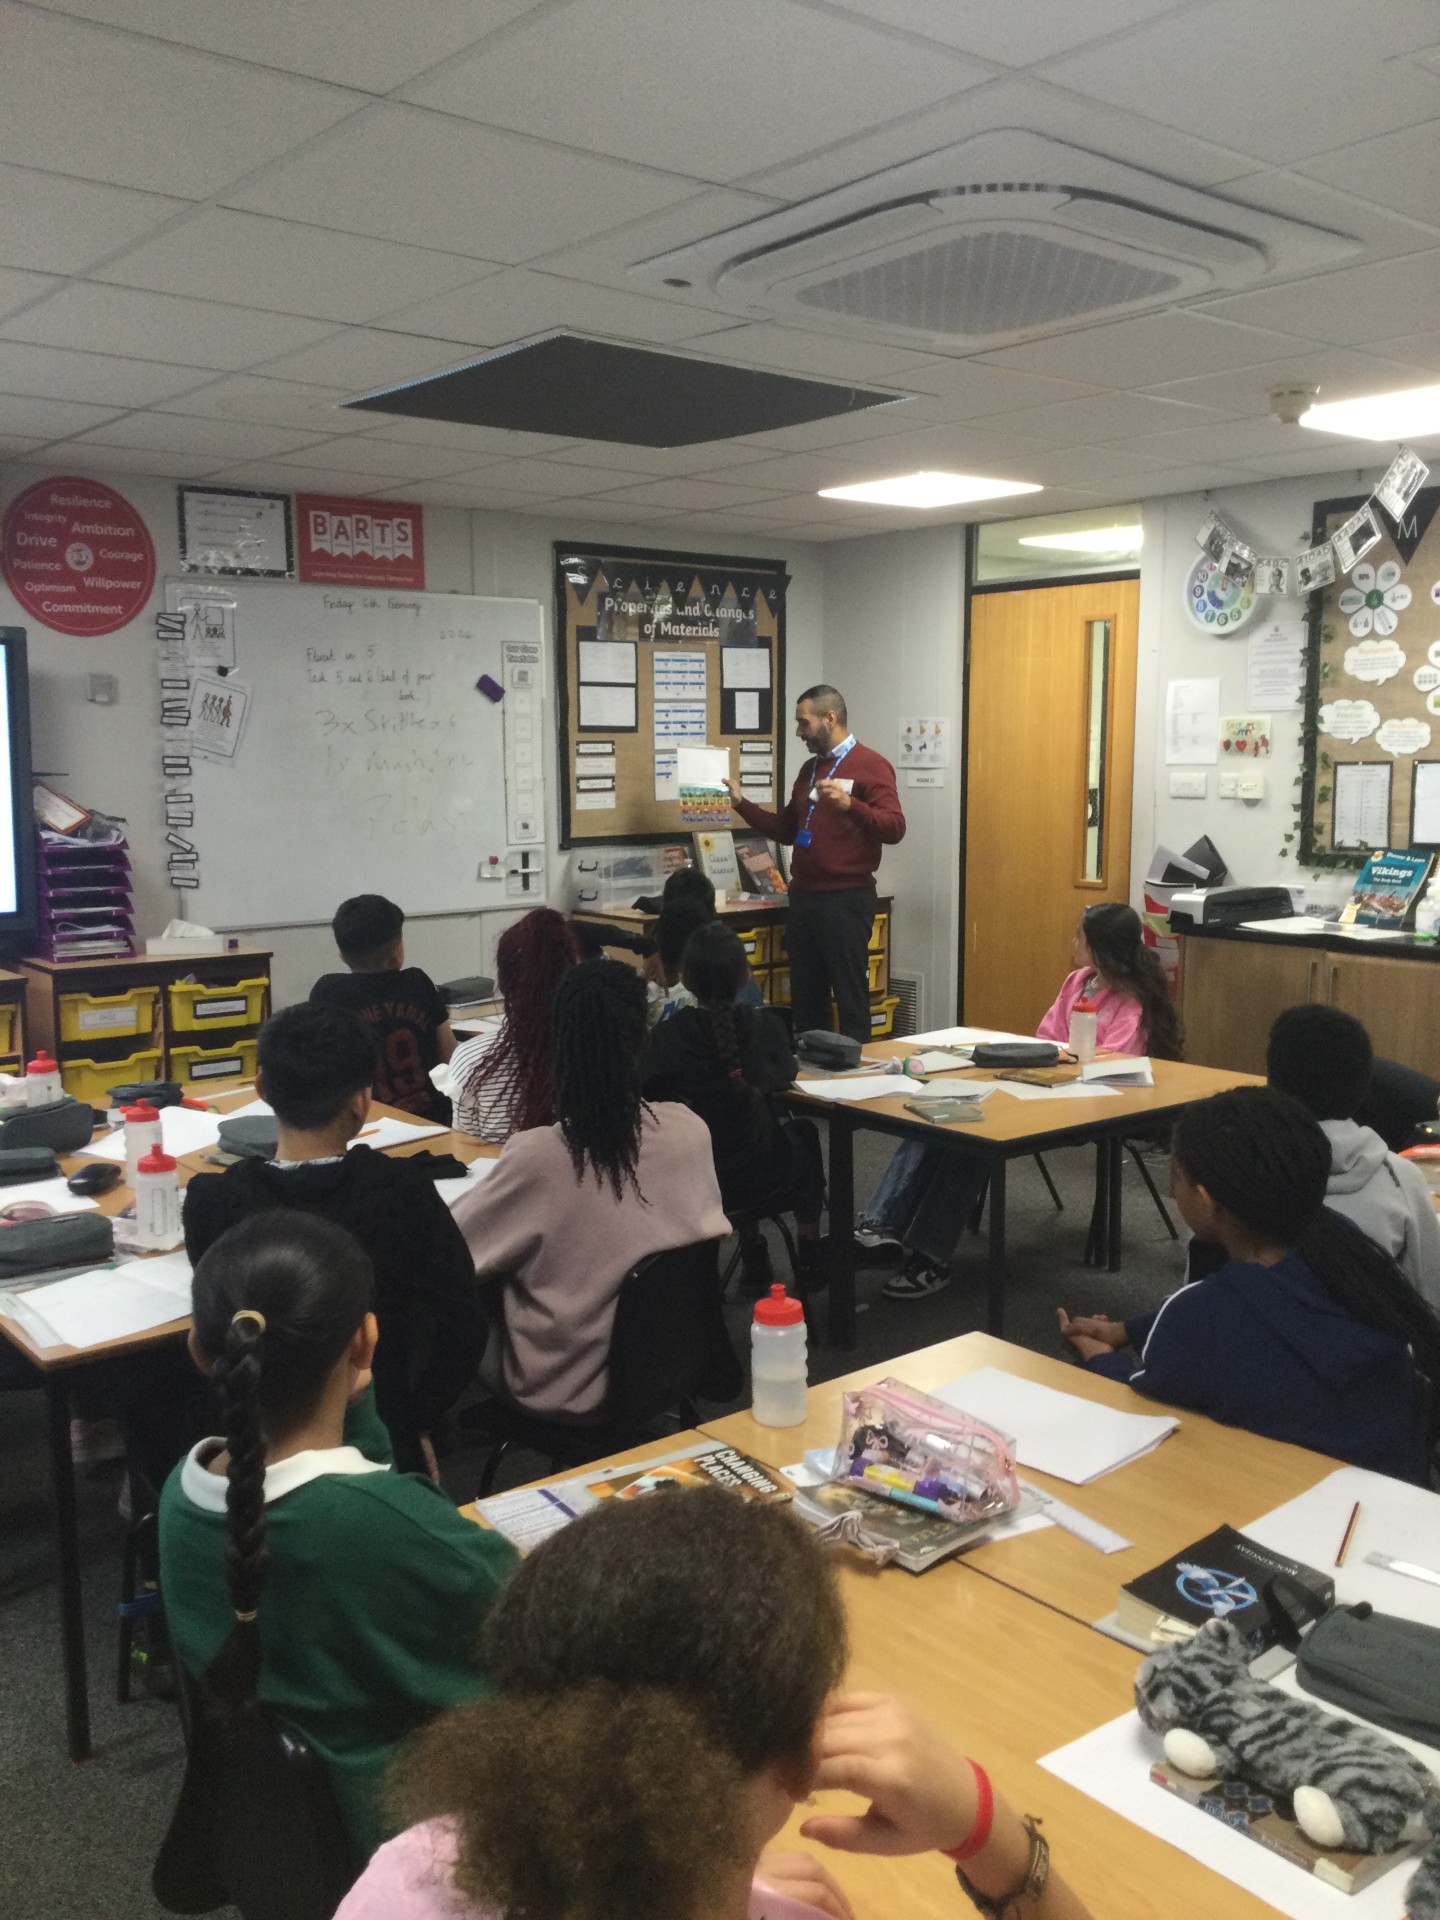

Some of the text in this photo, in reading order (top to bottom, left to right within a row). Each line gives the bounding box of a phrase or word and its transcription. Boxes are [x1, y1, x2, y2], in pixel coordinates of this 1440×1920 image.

[51, 494, 111, 509] Resilience
[25, 511, 67, 524] Integrity
[72, 522, 134, 537] Ambition
[313, 514, 408, 544] BARTS
[1398, 515, 1418, 539] M
[16, 532, 57, 547] Drive
[100, 548, 144, 562] Courage
[14, 559, 62, 571] Patience
[25, 582, 76, 594] Optimism
[83, 576, 142, 590] Willpower
[42, 601, 123, 614] Commitment
[323, 594, 355, 615] Friday
[644, 621, 720, 638] of Materials
[1371, 866, 1413, 879] Vikings
[693, 1454, 742, 1488] PLACES
[715, 1449, 777, 1493] CHANGING
